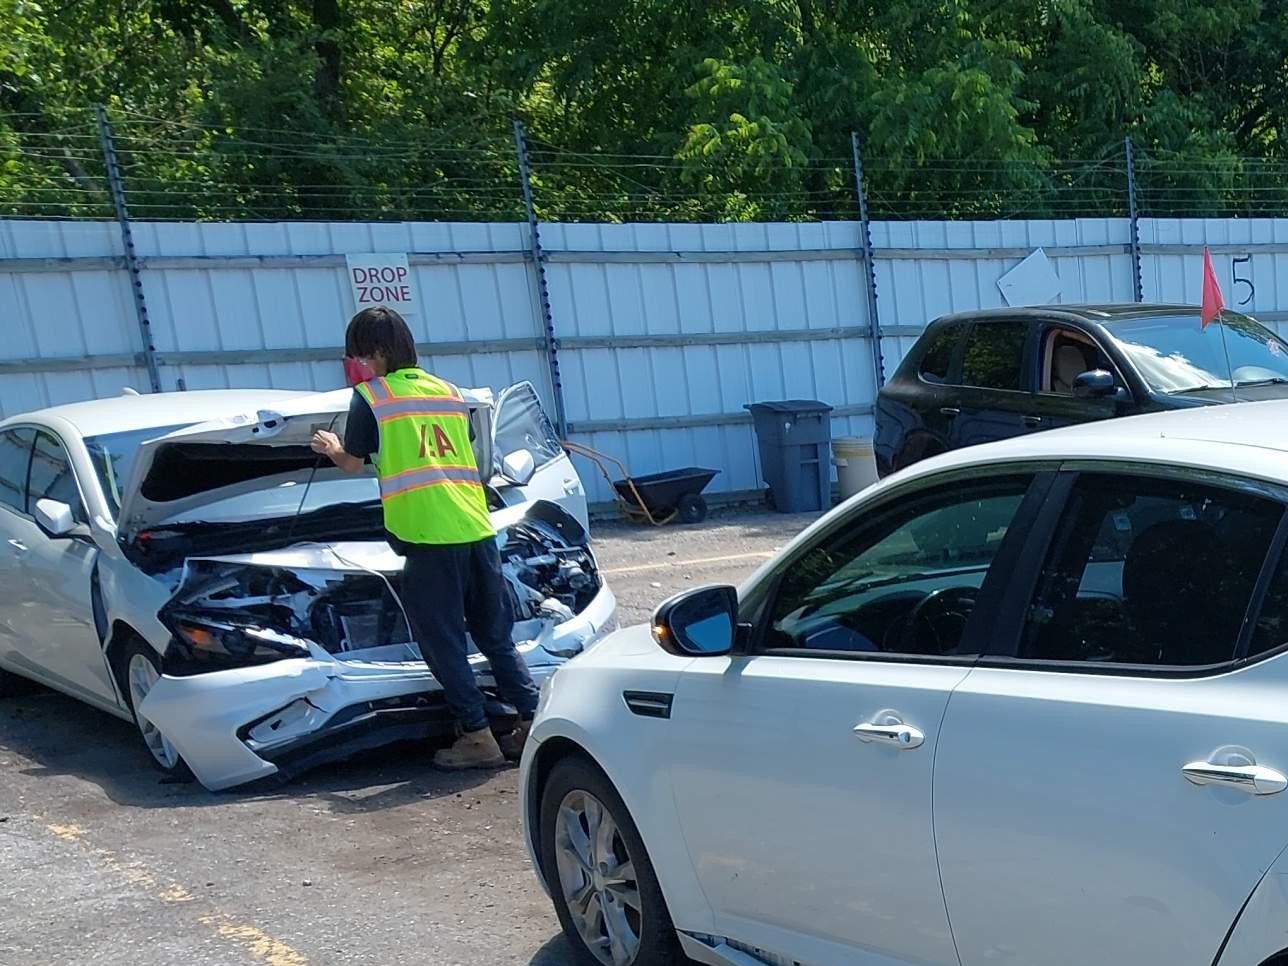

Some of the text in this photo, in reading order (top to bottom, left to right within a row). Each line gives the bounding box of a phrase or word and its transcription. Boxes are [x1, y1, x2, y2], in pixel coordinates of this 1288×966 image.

[352, 267, 407, 284] DROP
[1232, 254, 1255, 305] 5
[357, 286, 412, 302] ZONE
